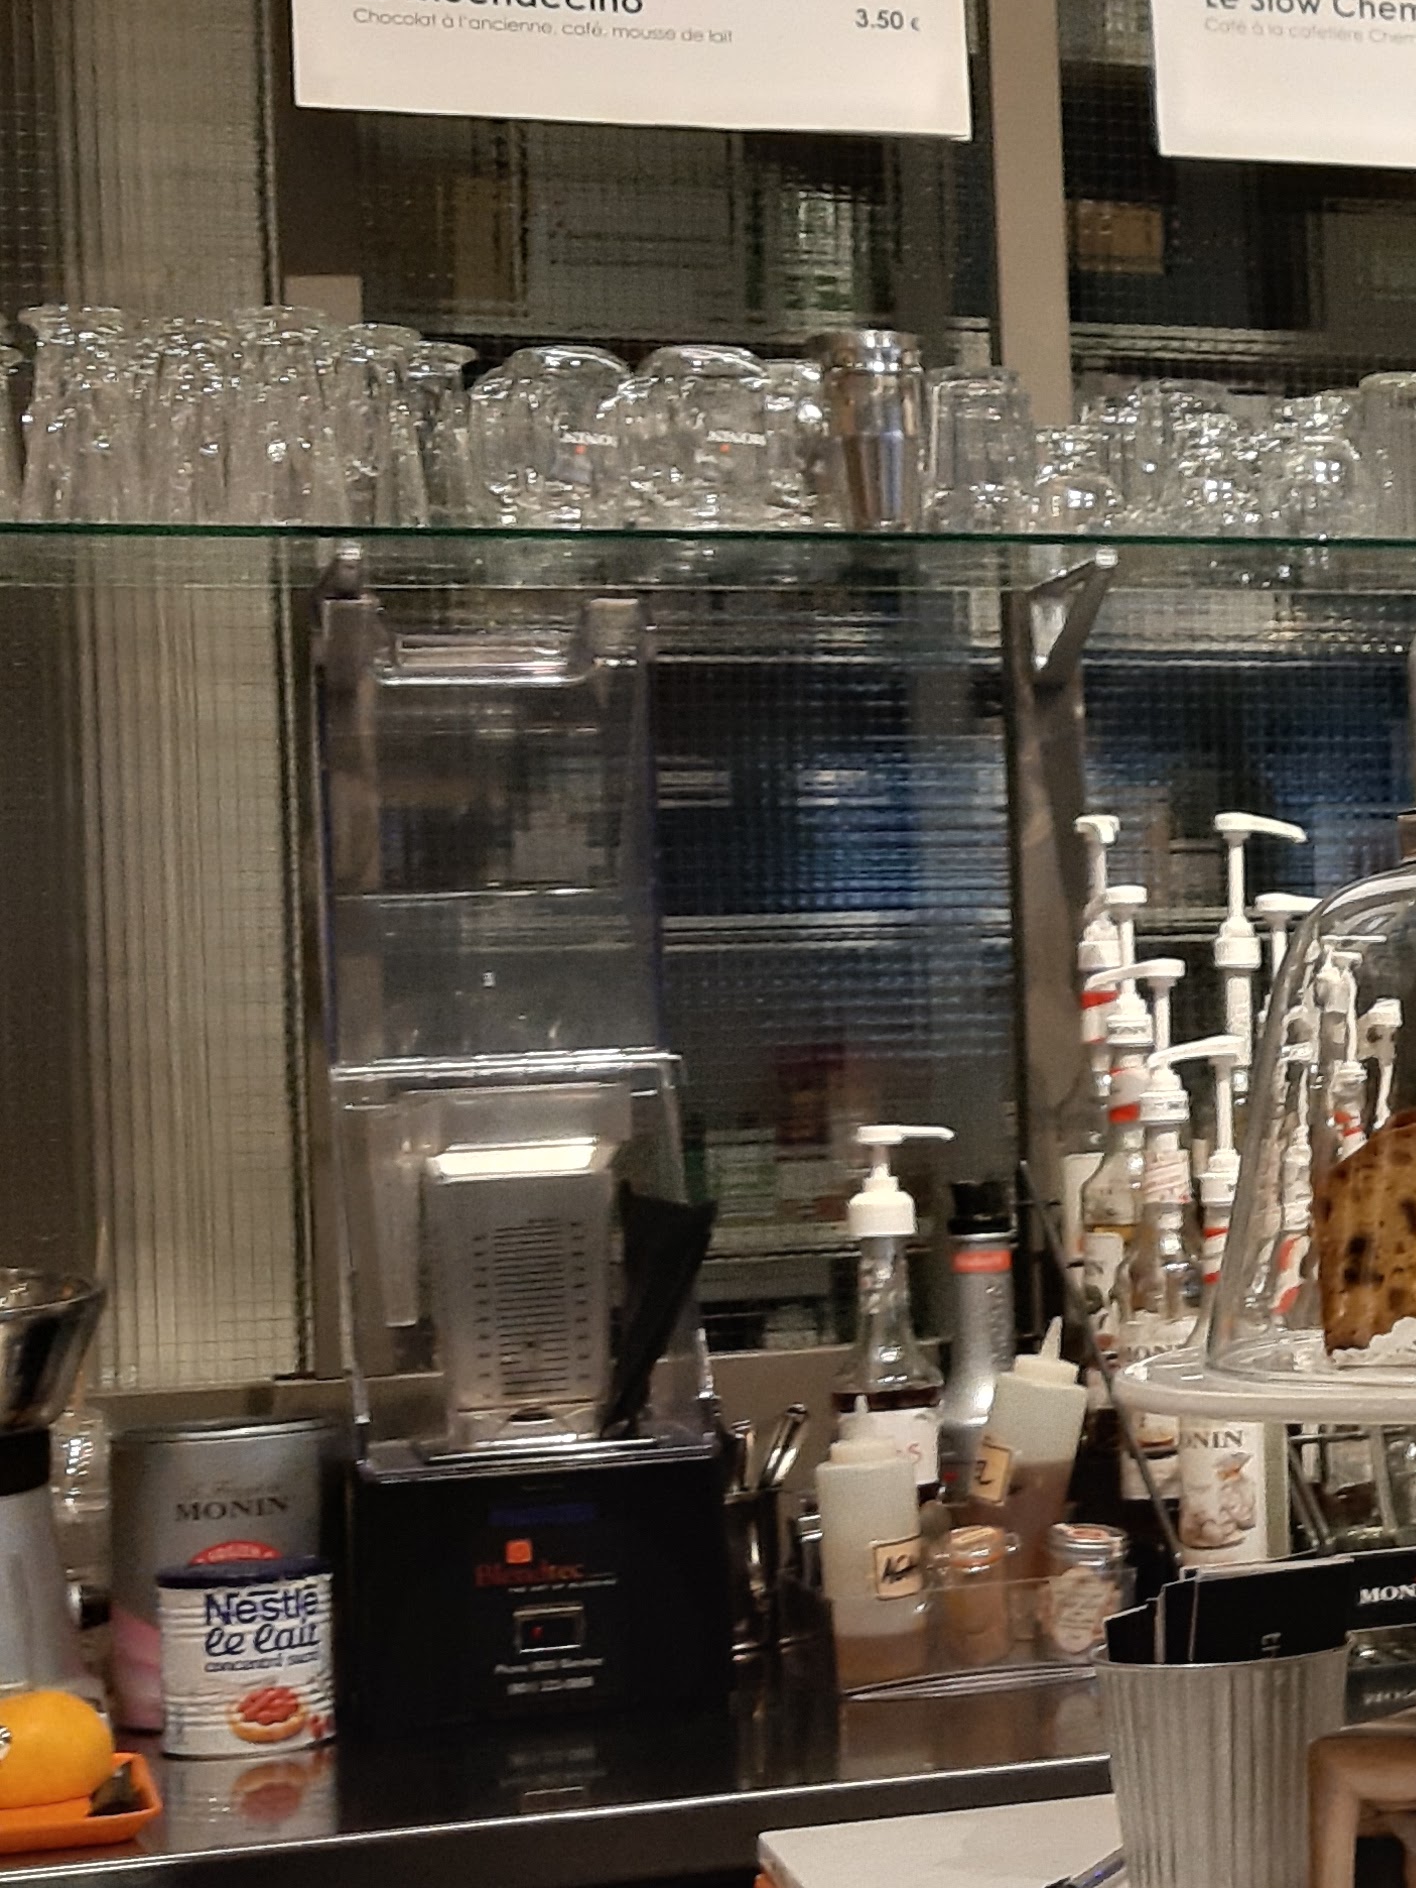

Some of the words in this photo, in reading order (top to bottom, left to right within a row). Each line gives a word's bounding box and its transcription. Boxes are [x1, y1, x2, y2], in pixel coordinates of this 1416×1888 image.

[856, 8, 904, 30] 3.50
[1184, 1429, 1244, 1448] NIN
[175, 1494, 289, 1522] MONIN
[205, 1584, 320, 1625] Nestlé
